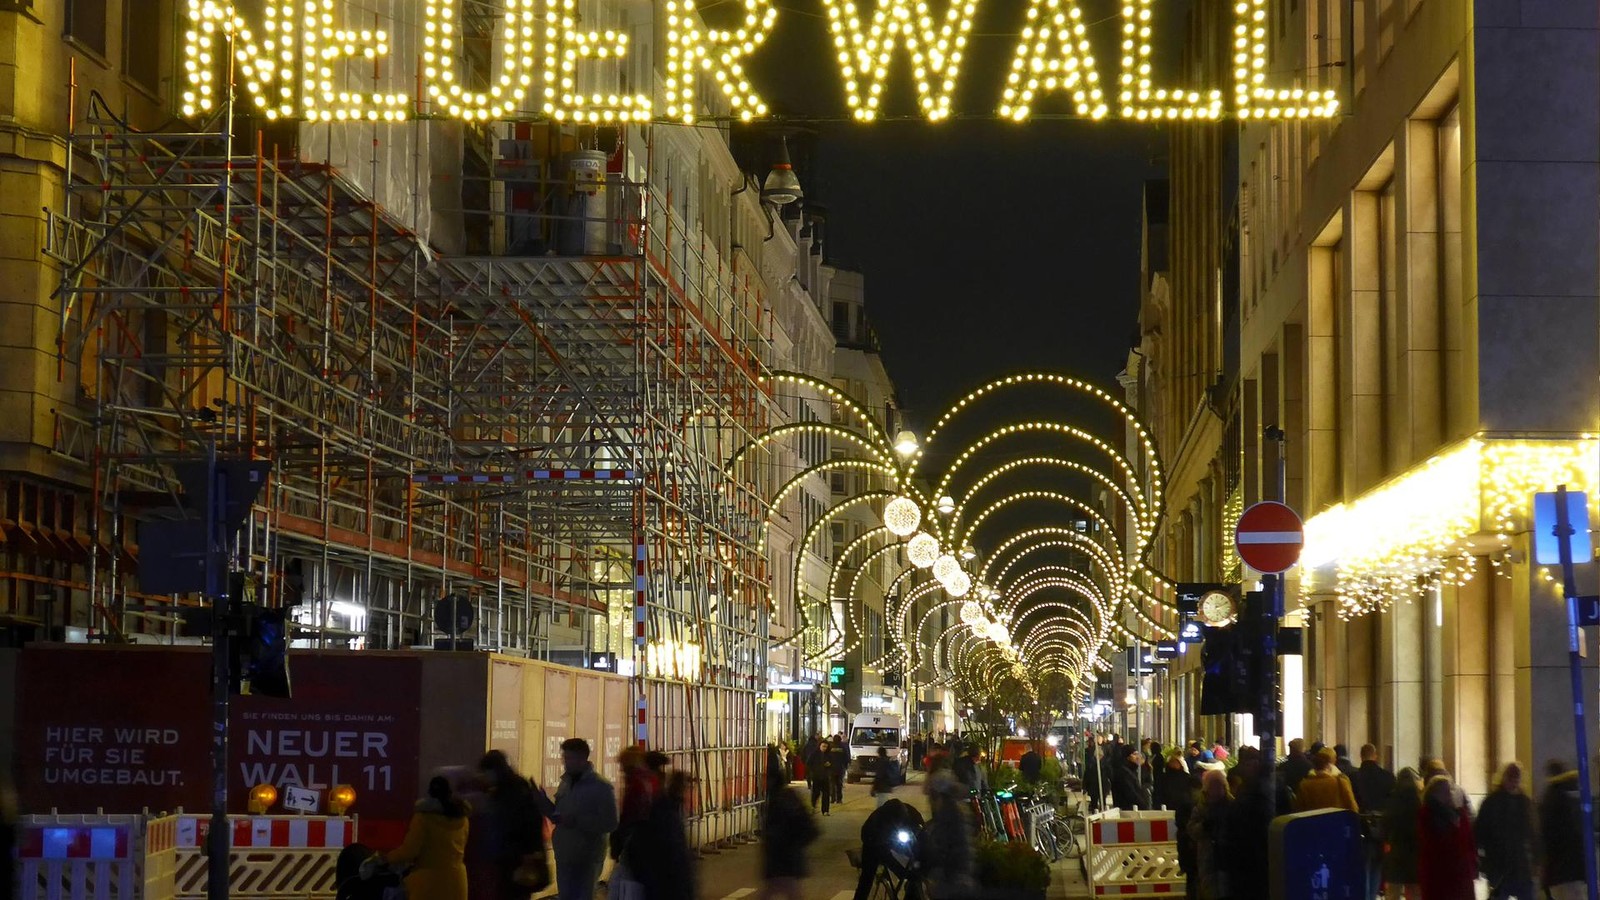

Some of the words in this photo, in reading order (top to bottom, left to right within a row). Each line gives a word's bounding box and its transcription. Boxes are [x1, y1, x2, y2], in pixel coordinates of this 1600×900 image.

[180, 0, 778, 122] NEUER
[823, 0, 1339, 122] WALL
[242, 712, 258, 720] SIE
[261, 712, 298, 721] FINDEN
[301, 713, 321, 721] UNS
[325, 714, 341, 722] BIS
[344, 714, 375, 722] DAHIN
[46, 727, 104, 743] HIER
[114, 728, 180, 745] WIRD
[247, 730, 389, 758] NEUER
[45, 743, 94, 763] FÜR
[105, 748, 145, 764] SIE
[44, 768, 185, 786] UMGEBAUT.
[240, 762, 350, 790] WALL
[363, 765, 392, 791] 11
